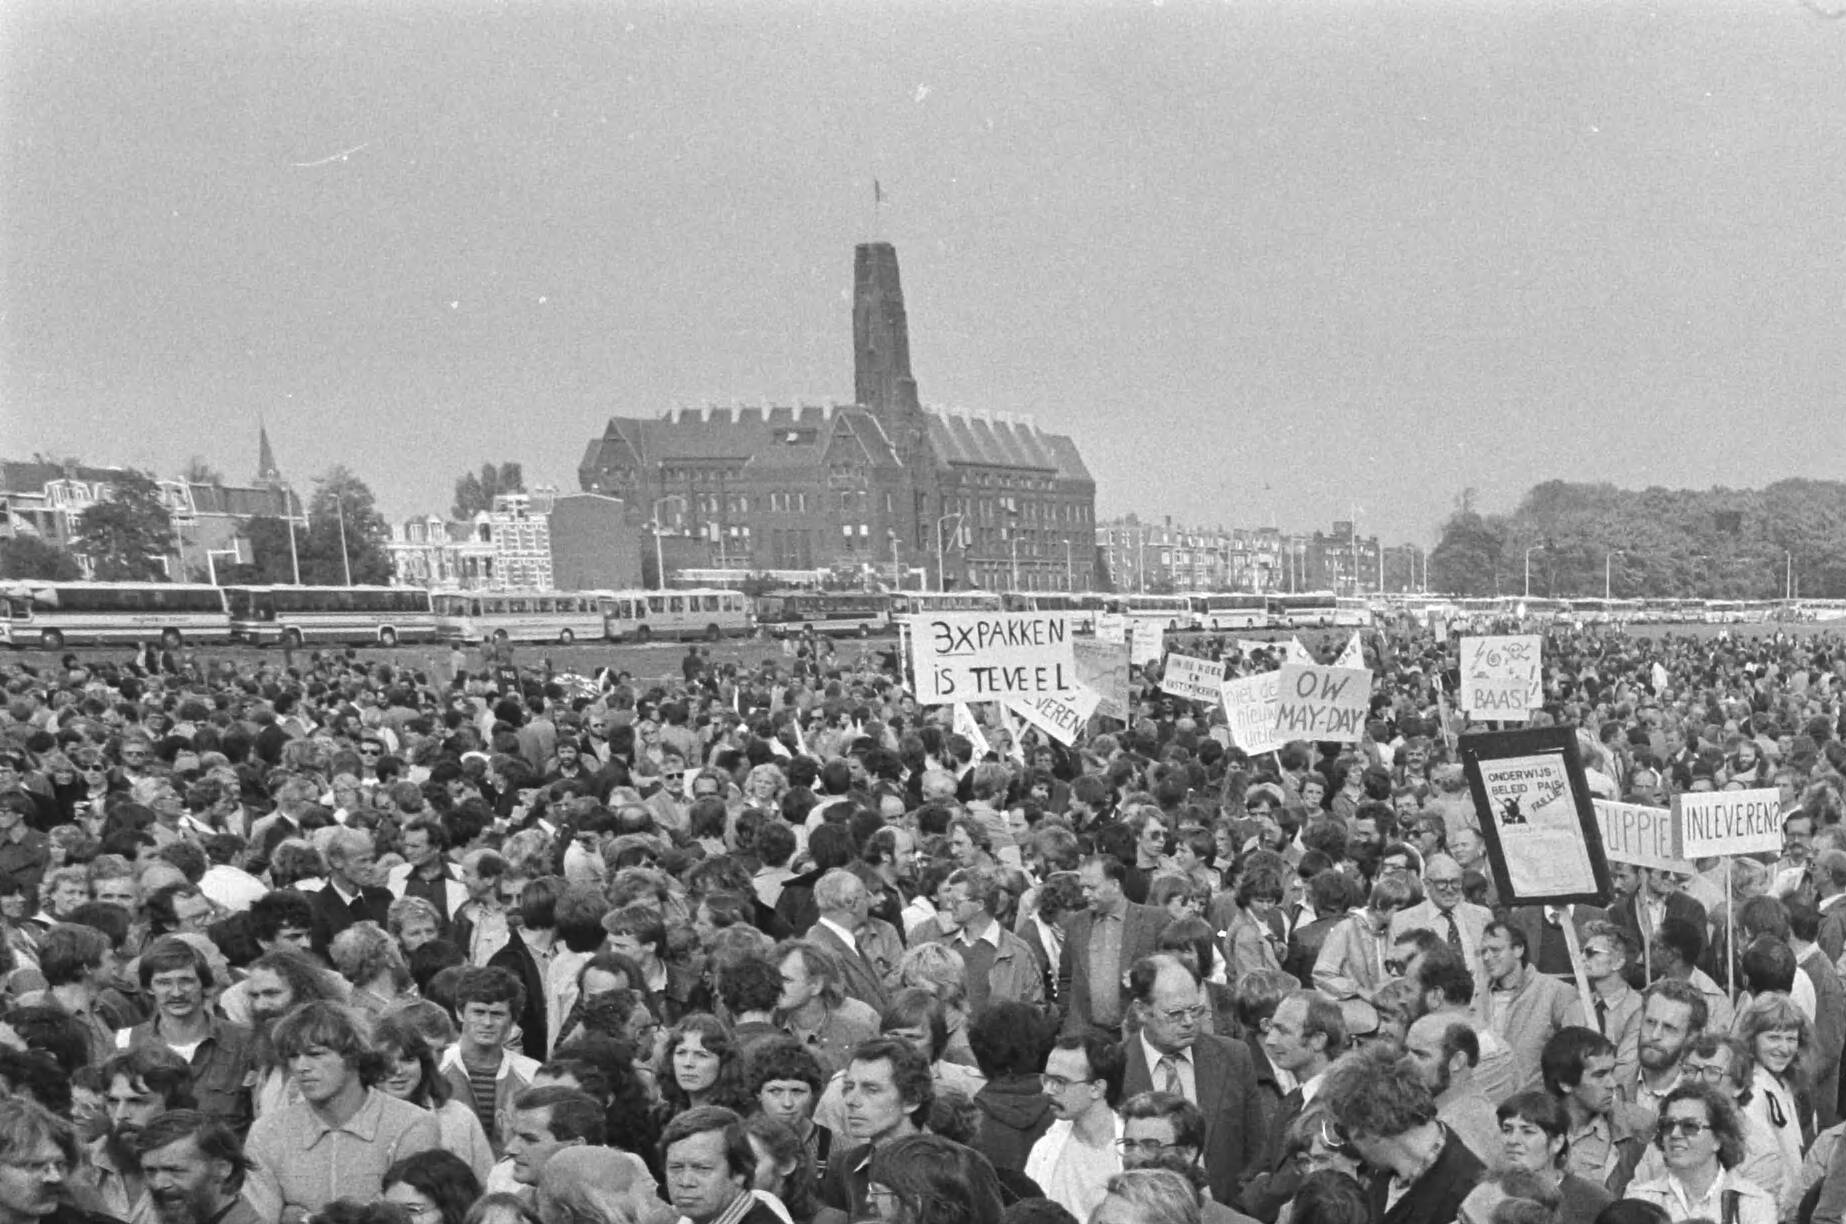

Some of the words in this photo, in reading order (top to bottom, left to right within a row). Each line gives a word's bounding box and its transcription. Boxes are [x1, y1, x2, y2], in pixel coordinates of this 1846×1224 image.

[969, 663, 1069, 694] TEVEEL
[1275, 704, 1363, 734] MAY-DAY
[1491, 783, 1528, 795] BELEID
[1686, 801, 1781, 841] INLEVEREN?
